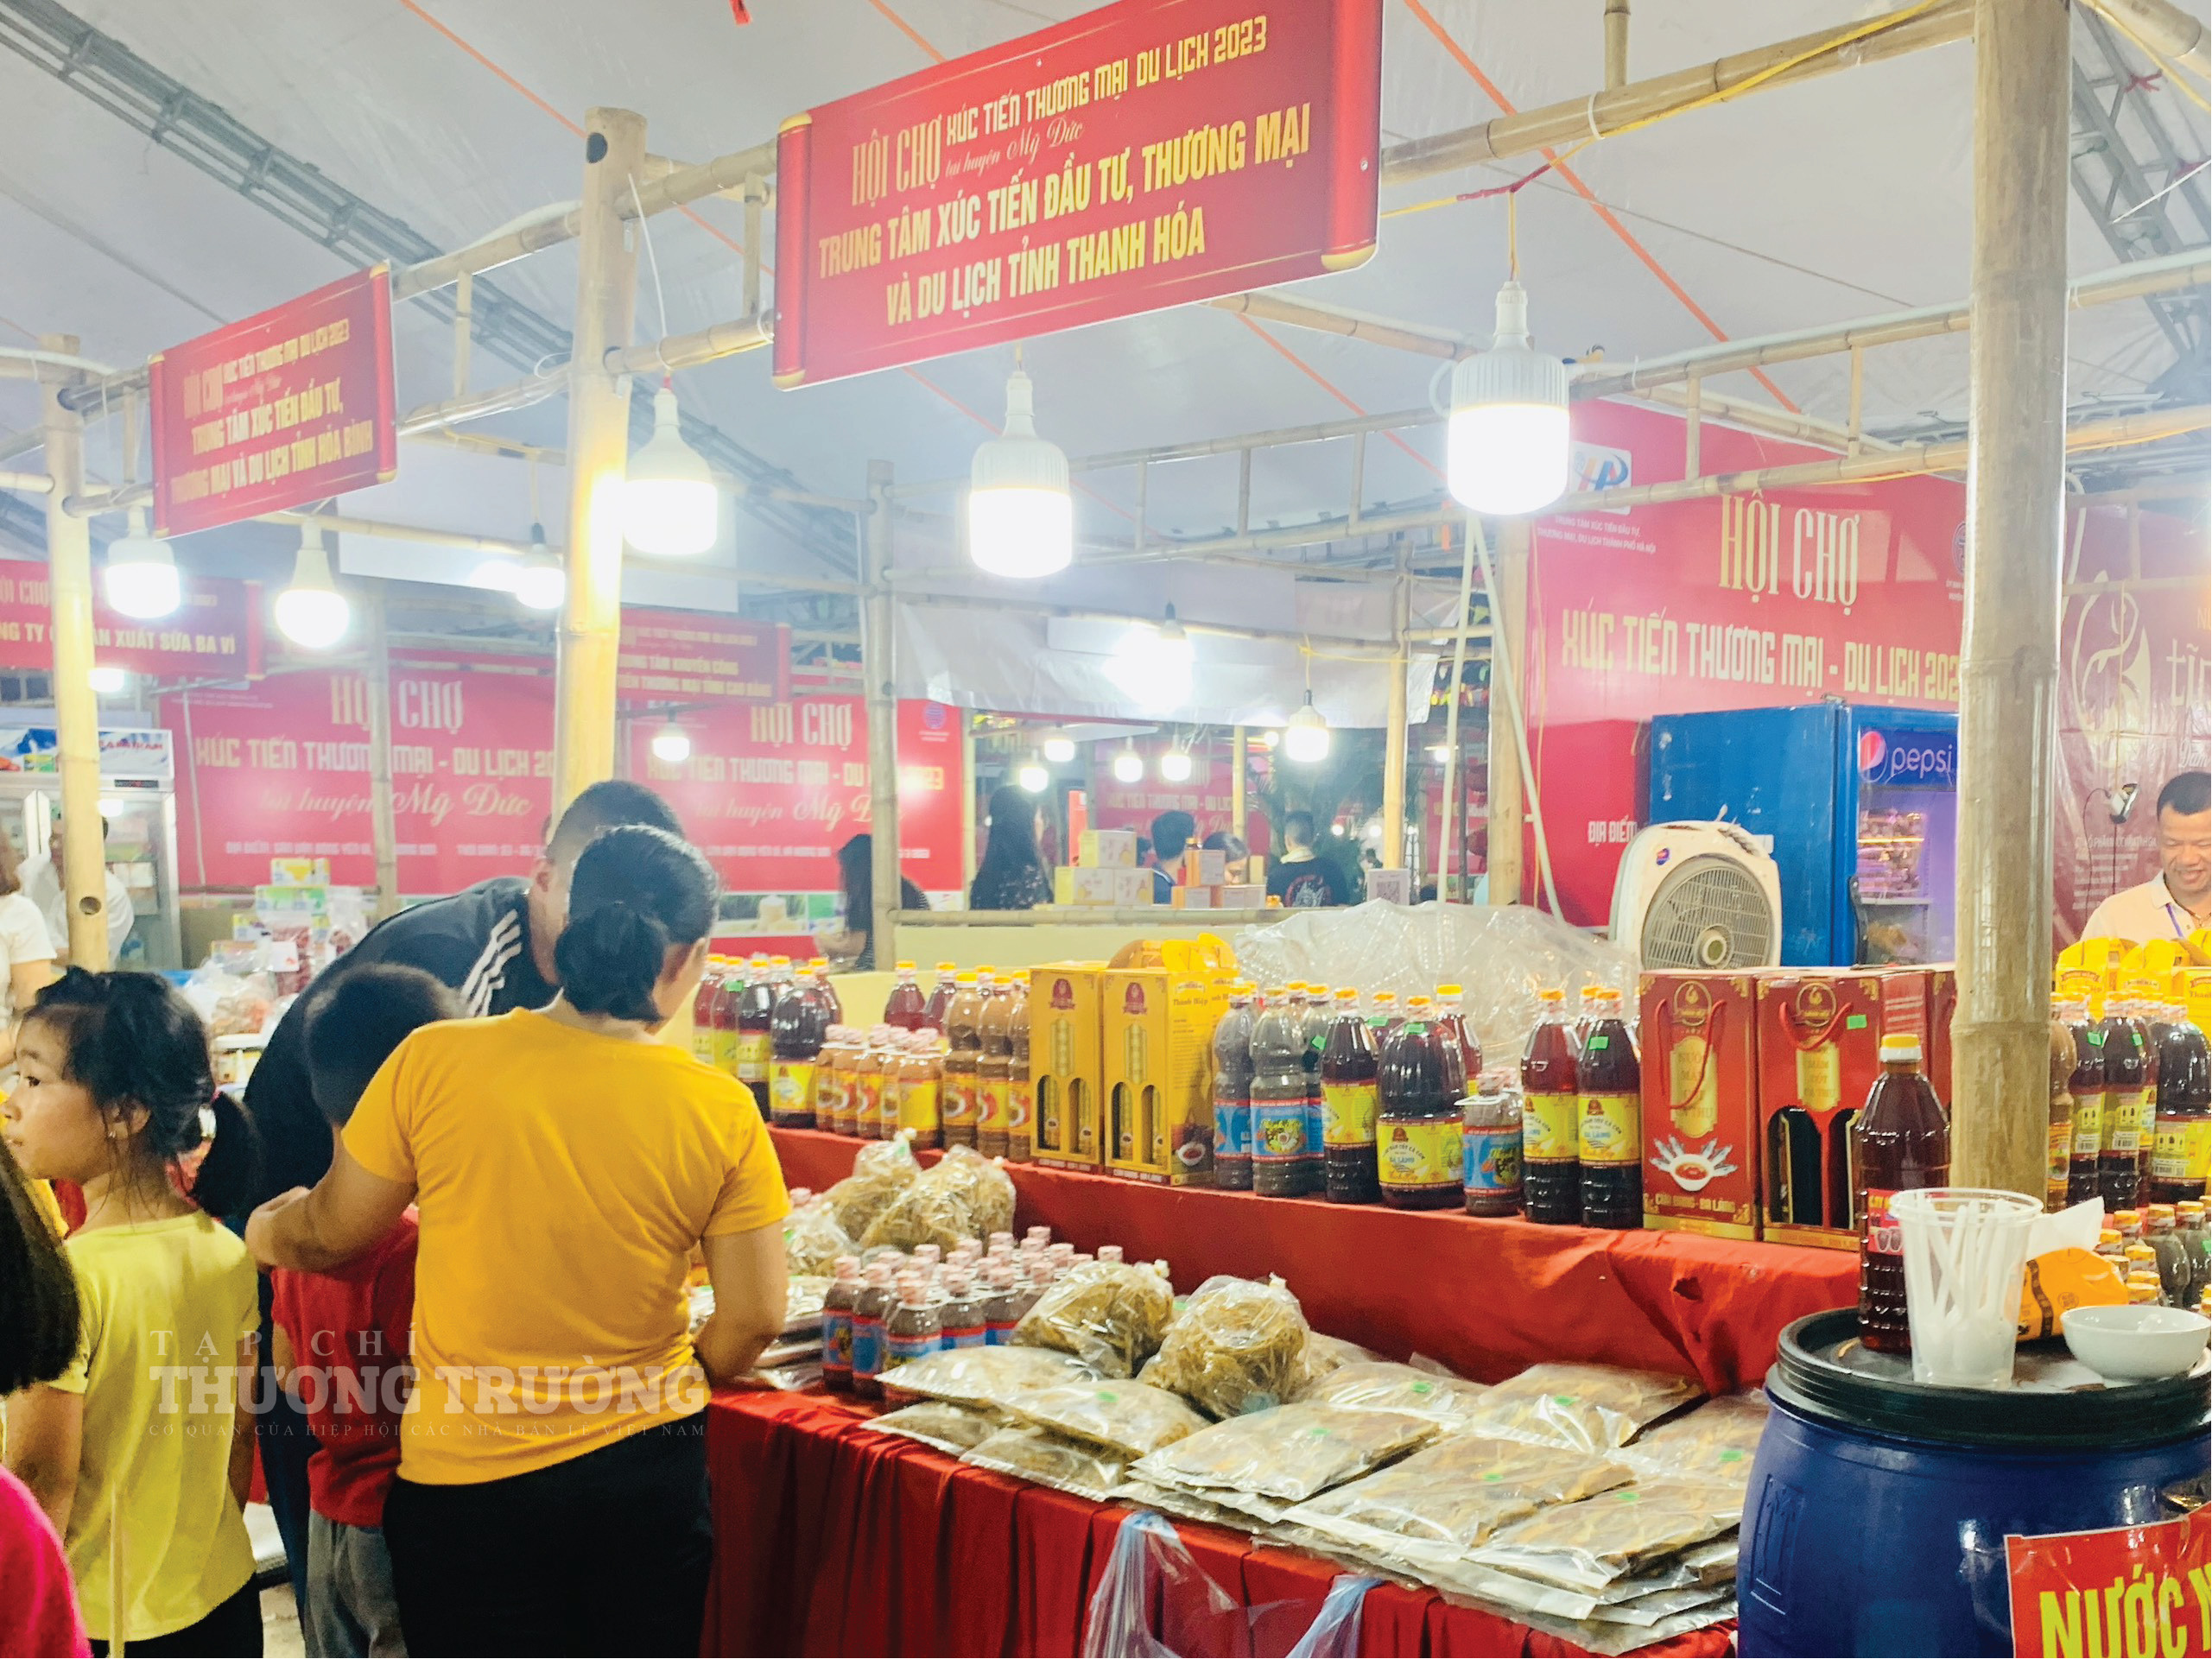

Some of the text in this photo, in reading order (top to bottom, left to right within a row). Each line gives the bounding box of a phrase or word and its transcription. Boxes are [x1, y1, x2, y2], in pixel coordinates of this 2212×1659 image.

[852, 16, 1267, 207] HỘI CHỢ XÚC TIẾN THƯƠNG MẠI DU LỊCH 2023
[819, 102, 1310, 279] TRUNG TÂM XÚC TIẾN ĐẦU TƯ, THƯƠNG MẠI
[886, 199, 1206, 326] VÀ DU LỊCH TỈNH THANH HÓA
[1718, 490, 1860, 617] HỘI CHỢ
[24, 623, 44, 643] TY
[1562, 596, 1615, 671] XÚC
[1622, 607, 1678, 676] TIẾN
[1686, 623, 1777, 686] THƯƠNG
[1781, 633, 1823, 697] MẠI
[1844, 641, 1870, 693] DU
[1876, 643, 1920, 705] LỊCH
[1924, 650, 1960, 701] 202
[331, 674, 463, 735] HỘ CHỢ
[802, 703, 852, 751] CHỢ
[246, 735, 297, 769] TIẾN
[303, 741, 371, 772] THƯƠN
[393, 744, 434, 779] MẠI
[453, 747, 480, 776] DU
[485, 749, 529, 781] LỊCH
[1891, 744, 1954, 777] pepsi
[1588, 820, 1607, 847] ĐỊA
[2039, 1564, 2188, 1657] NƯỚC
